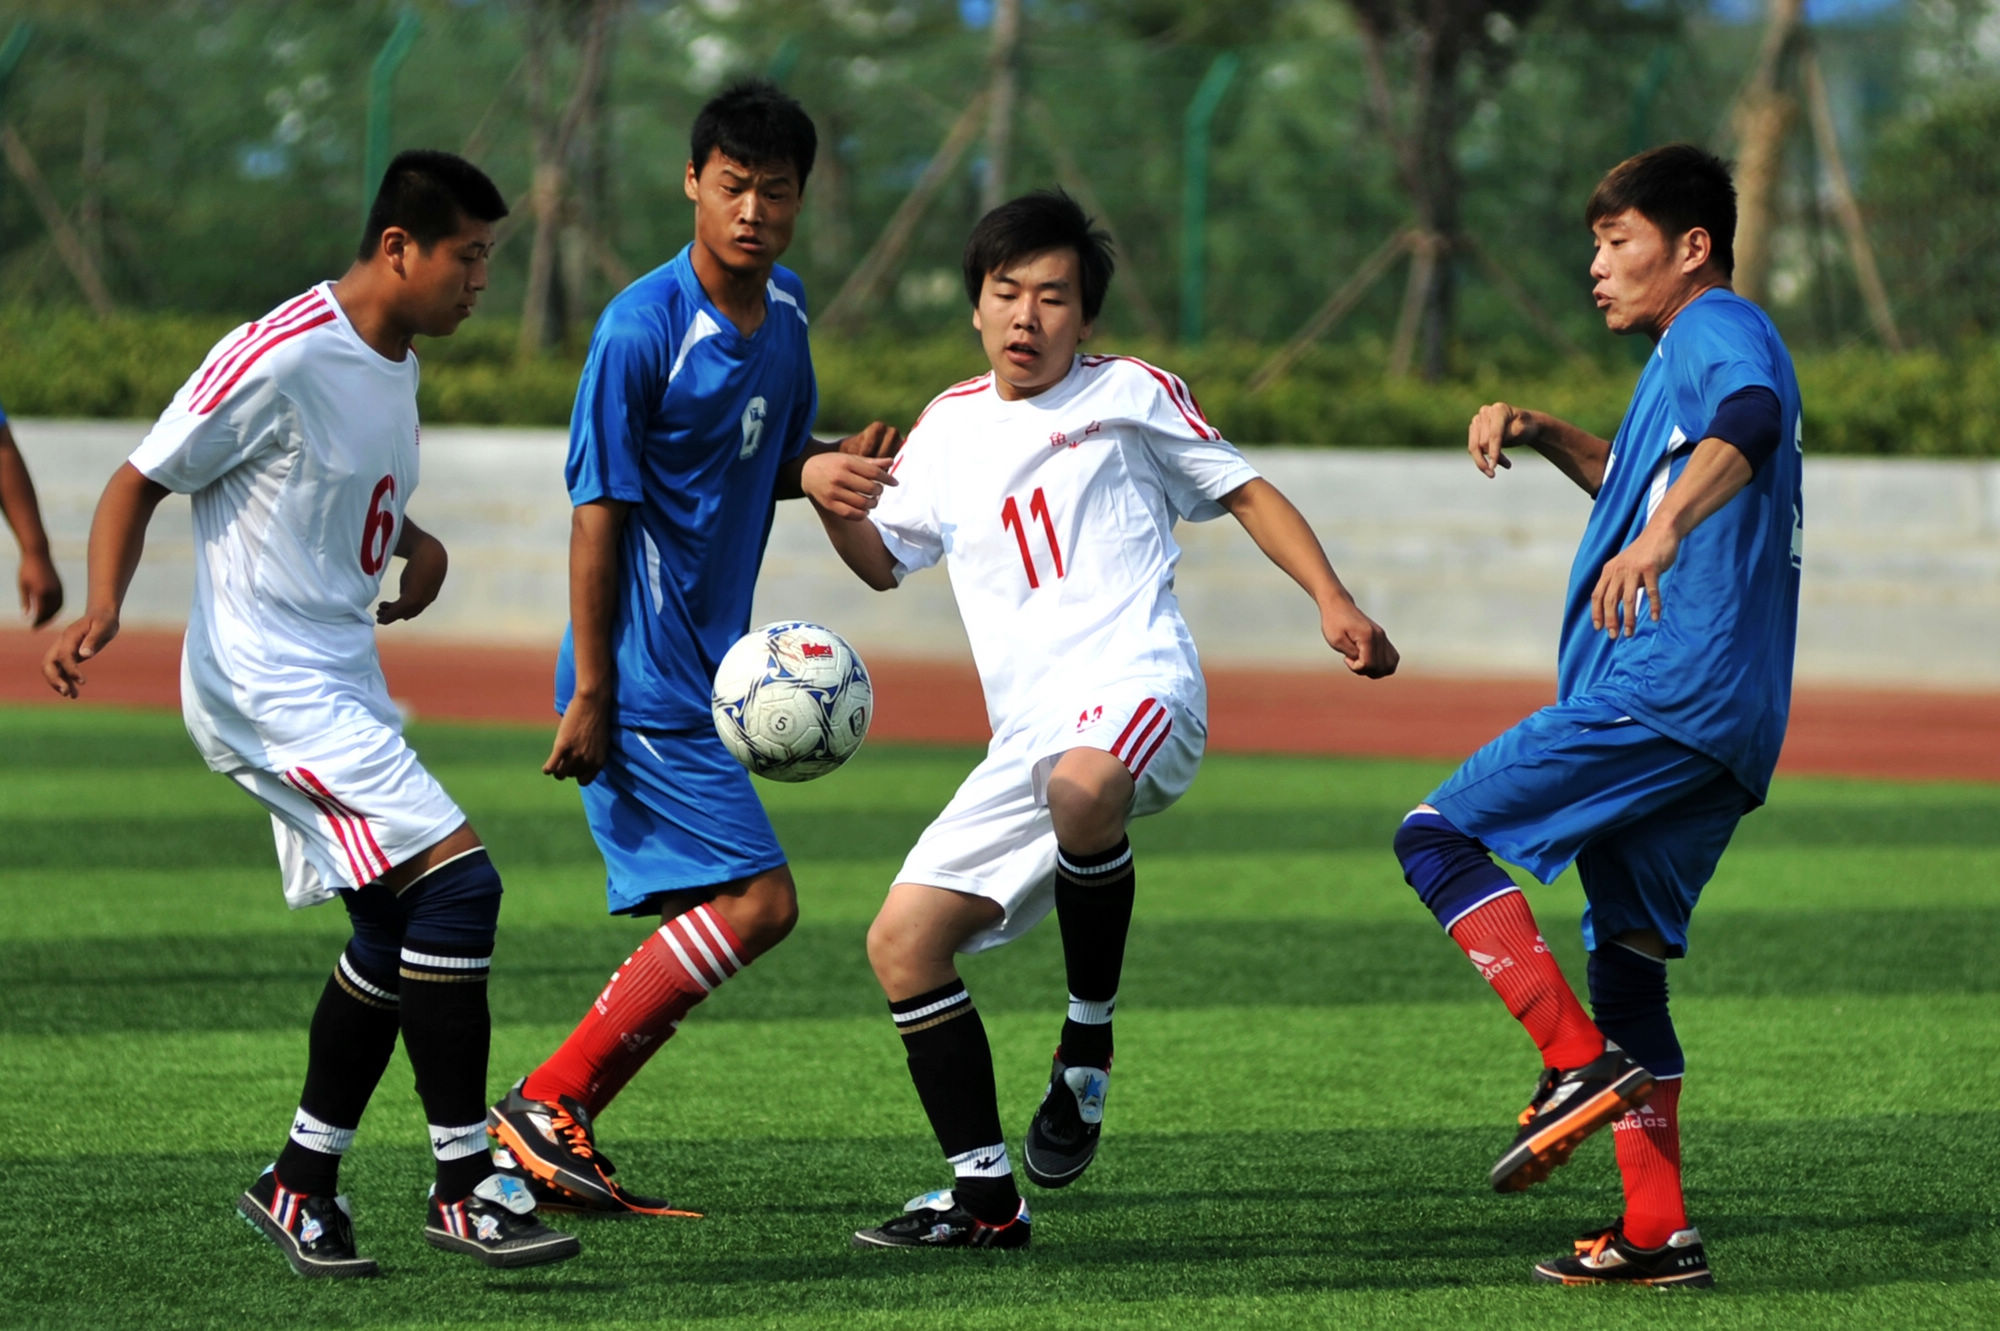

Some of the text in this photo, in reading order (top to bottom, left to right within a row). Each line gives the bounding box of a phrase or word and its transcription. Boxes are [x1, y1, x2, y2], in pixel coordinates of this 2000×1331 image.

[740, 395, 767, 459] 6
[360, 474, 395, 576] 6
[1001, 486, 1064, 589] 11
[775, 716, 788, 731] 5
